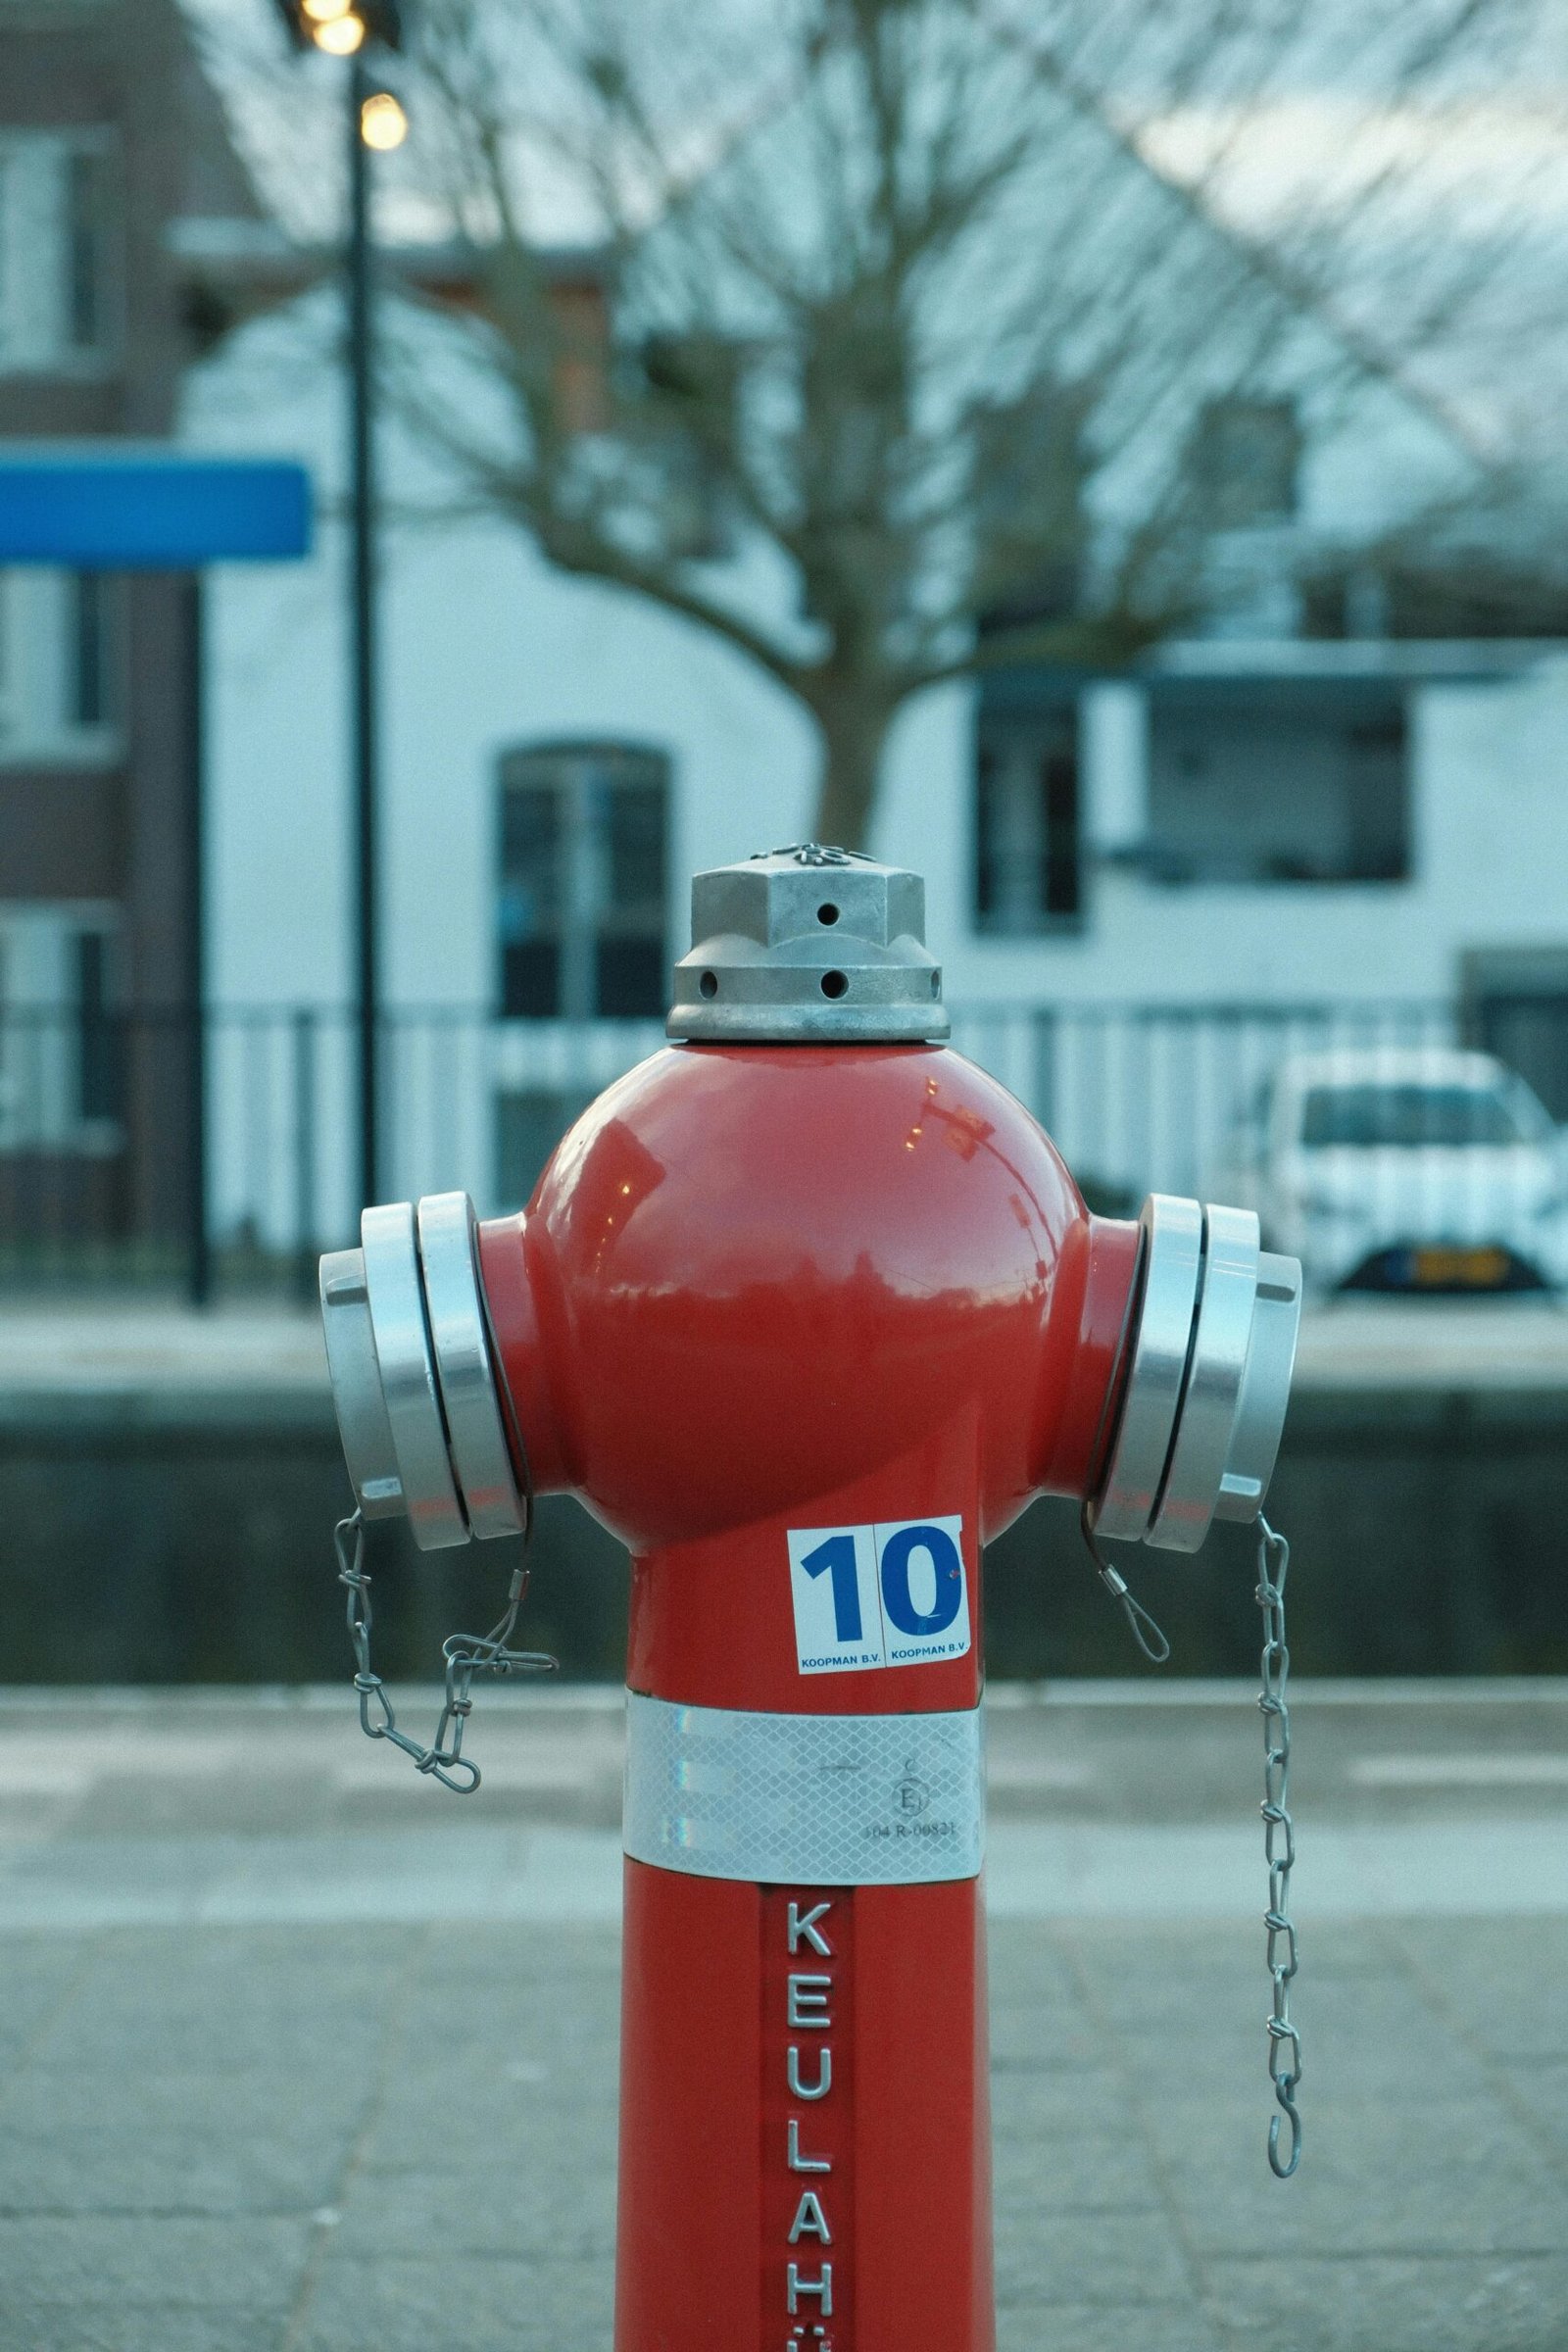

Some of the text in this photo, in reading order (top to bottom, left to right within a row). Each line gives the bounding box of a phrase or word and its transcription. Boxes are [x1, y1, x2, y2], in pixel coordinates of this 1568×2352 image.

[801, 1525, 962, 1642] 10
[891, 1642, 968, 1659] KOOPMAN B.V.
[802, 1653, 881, 1668] KOOPMAN B.V.
